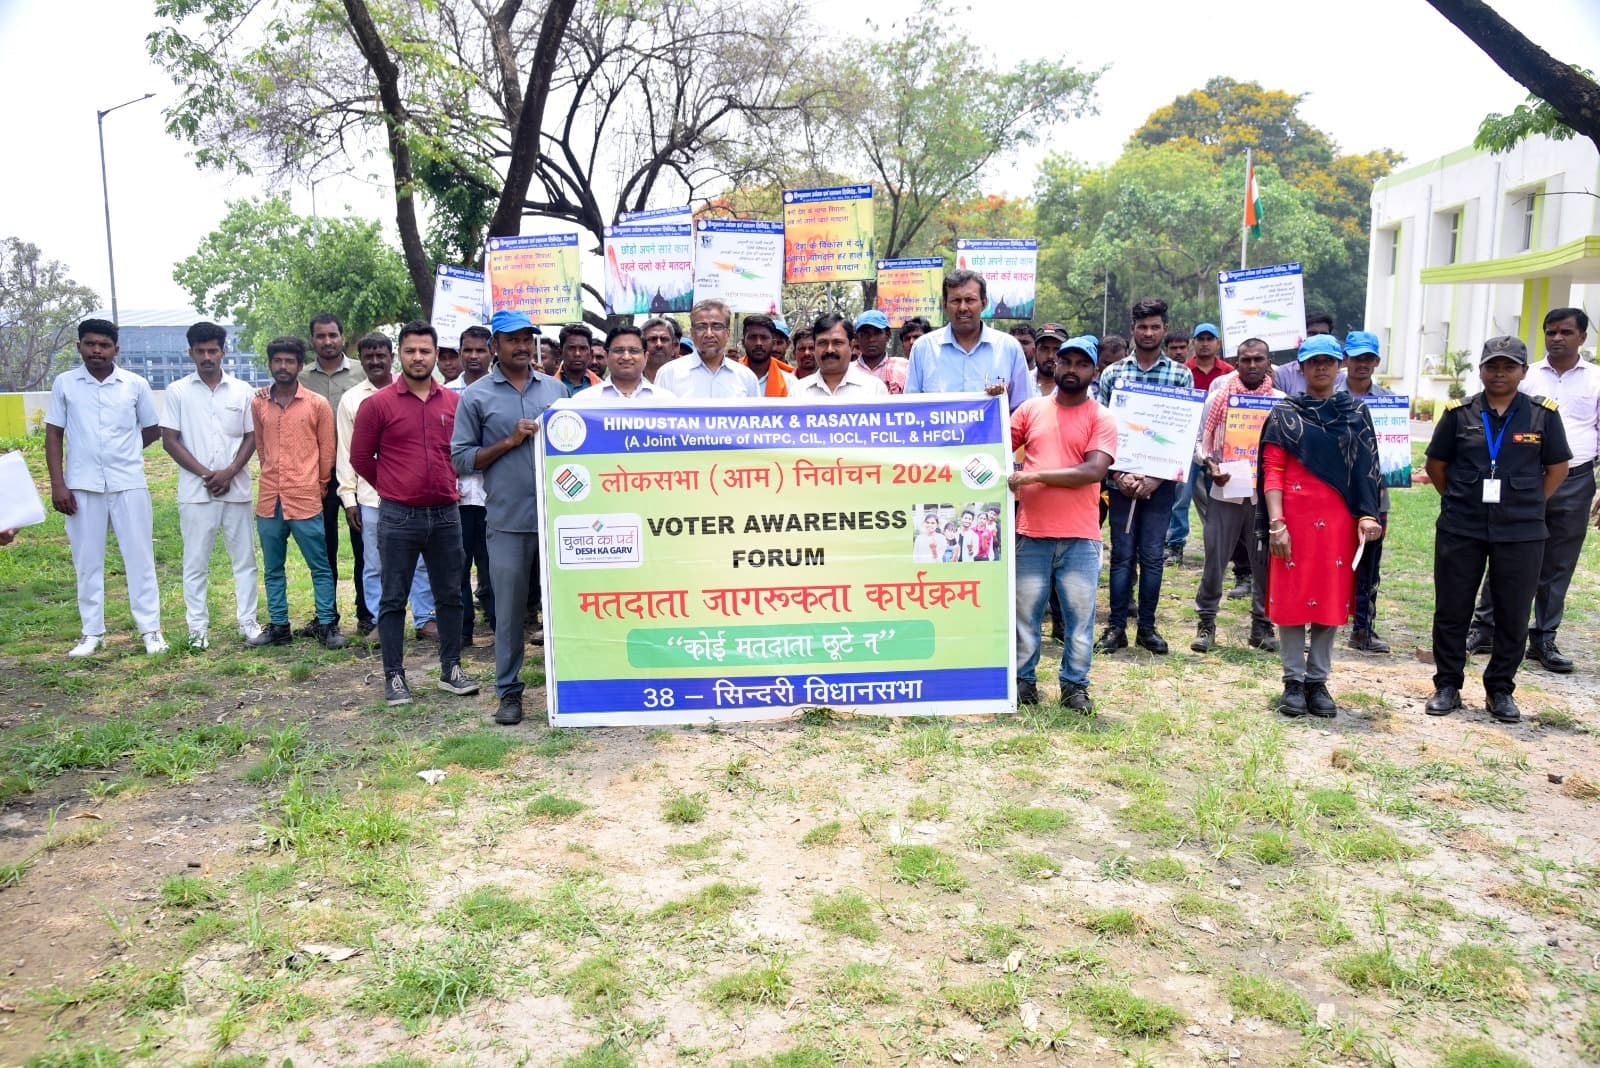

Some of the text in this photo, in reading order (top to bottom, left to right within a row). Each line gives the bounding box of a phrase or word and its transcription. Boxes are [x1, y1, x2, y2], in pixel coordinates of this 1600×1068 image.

[669, 260, 691, 271] मतदान
[1014, 272, 1034, 280] मतदान
[603, 410, 984, 431] HINDUSTAN URVARAK & RASAYAN LTD., SINDRI
[624, 430, 964, 450] (A Joint Venture of NTPC, CIL, IOCL, FCIL, & HFCL)
[1384, 434, 1408, 444] मतदान
[598, 464, 699, 492] लोकसभा
[792, 458, 882, 486] निर्वाचन
[892, 463, 952, 484] 2024
[648, 510, 907, 536] VOTER AWARENESS
[562, 530, 634, 550] चुनाव का पर्व
[610, 546, 632, 554] GARV
[732, 548, 825, 568] FORUM
[578, 571, 981, 620] मतदाता जागरूकता कार्यक्रम
[734, 635, 814, 659] मतदाता
[822, 626, 854, 660] छूटे
[643, 688, 674, 708] 38
[713, 677, 794, 706] सिन्दरी
[804, 676, 923, 703] विधानसभा
